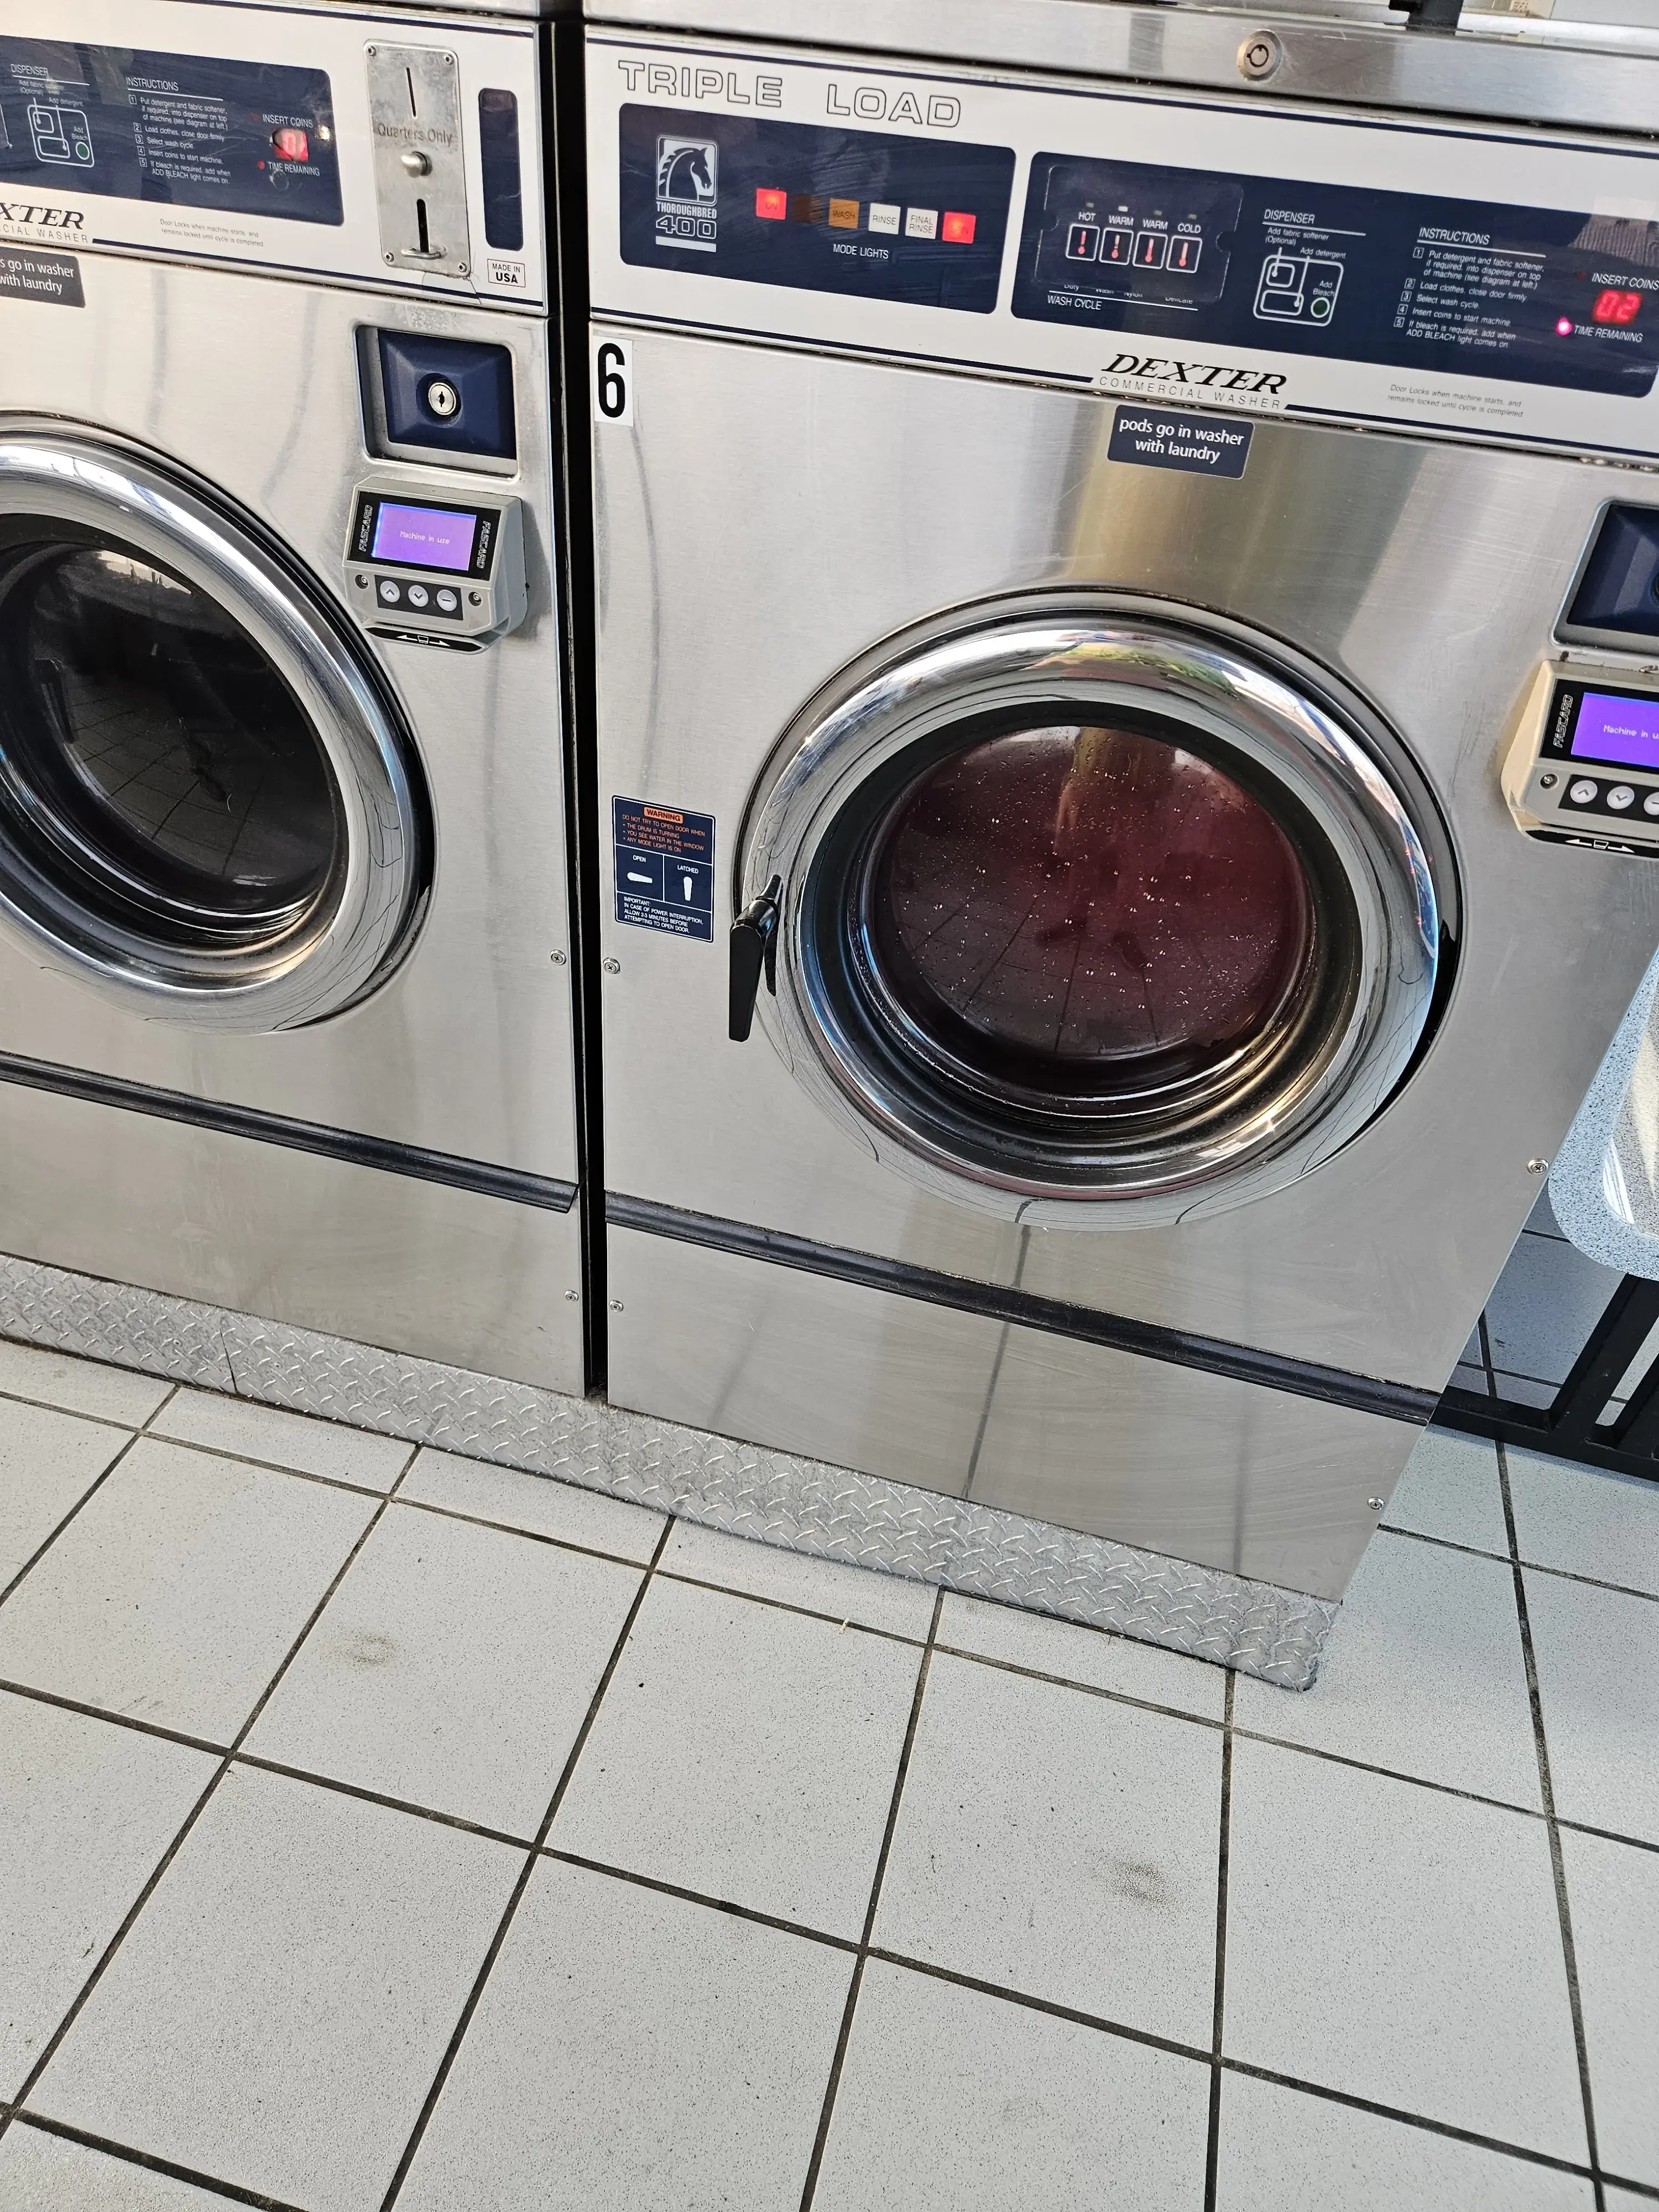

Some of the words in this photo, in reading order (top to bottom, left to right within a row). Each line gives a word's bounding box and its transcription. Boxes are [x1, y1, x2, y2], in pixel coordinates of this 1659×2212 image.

[11, 64, 49, 76] DISPENSER
[126, 77, 179, 91] INSTRUCTIONS
[618, 60, 782, 108] TRIPLE
[827, 84, 961, 128] LOAD
[263, 114, 288, 124] INSERT
[290, 117, 313, 128] COINS
[377, 123, 425, 141] Quarters
[428, 130, 452, 148] Only
[268, 161, 283, 172] TIME
[285, 164, 320, 176] REMAINING
[656, 201, 717, 219] THOROUGHBRED
[832, 210, 855, 220] WASH
[1079, 212, 1095, 221] HOT
[1264, 208, 1315, 224] DISPENSER
[656, 215, 716, 239] 400
[873, 215, 896, 225] RINSE
[911, 215, 933, 225] FINAL
[1109, 215, 1134, 226] WARM
[1143, 219, 1168, 230] WARM
[0, 224, 30, 236] CIAL
[37, 228, 88, 243] WASHER
[909, 224, 933, 233] RINSE
[1177, 223, 1201, 234] COLD
[1283, 228, 1301, 237] fabric
[1419, 227, 1490, 245] INSTRUCTIONS
[1265, 235, 1296, 246] (Optional)
[833, 244, 857, 255] MODE
[860, 247, 889, 259] LIGHTS
[1429, 250, 1440, 259] Put
[1443, 253, 1476, 264] detergent
[1494, 256, 1512, 268] fabric
[8, 260, 21, 272] go
[24, 259, 34, 272] in
[37, 263, 74, 278] washer
[492, 263, 511, 272] MADE
[1481, 267, 1515, 277] dispenser
[1530, 272, 1541, 280] top
[0, 274, 20, 286] with
[23, 275, 62, 295] laundry
[496, 272, 519, 284] USA
[1433, 270, 1462, 280] machine
[1465, 274, 1479, 283] (see
[1481, 276, 1510, 286] diagram
[1592, 272, 1628, 286] INSERT
[1630, 277, 1659, 290] COINS
[1313, 288, 1335, 296] Bleach
[1420, 281, 1437, 291] Load
[1469, 288, 1487, 296] close
[1047, 295, 1072, 306] WASH
[1075, 299, 1102, 310] CYCLE
[1416, 294, 1438, 304] Select
[1597, 291, 1639, 320] 02
[1412, 308, 1432, 317] Insert
[1434, 310, 1452, 319] coins
[1463, 315, 1479, 323] start
[1416, 321, 1438, 330] bleach
[1425, 331, 1455, 341] BLEACH
[1458, 335, 1472, 345] light
[1474, 338, 1496, 347] comes
[1574, 325, 1594, 336] TIME
[1595, 328, 1644, 342] REMAINING
[598, 343, 625, 418] 6
[1101, 353, 1287, 394] DEXTER
[1100, 376, 1203, 399] COMMERCIAL
[1214, 392, 1280, 409] WASHER
[1119, 419, 1152, 432] pods
[1156, 424, 1175, 438] go
[1178, 425, 1190, 438] in
[1196, 428, 1244, 446] washer
[1135, 439, 1164, 453] with
[1168, 442, 1221, 464] laundry
[358, 505, 373, 552] FASCARD
[400, 531, 425, 541] Machine
[477, 520, 491, 569] FASCARD
[1553, 695, 1573, 748] FASCARD
[1604, 725, 1637, 737] Machine
[646, 808, 681, 821] WARNING
[659, 830, 680, 838] TURNING
[684, 842, 704, 851] WINDOW
[677, 864, 698, 874] LATCHED
[624, 896, 651, 906] IMPORTANT:
[624, 915, 653, 925] ATTEMPTING
[675, 925, 690, 933] DOOR.
[651, 908, 668, 916] POWER
[669, 912, 703, 925] INTERRUPTION,
